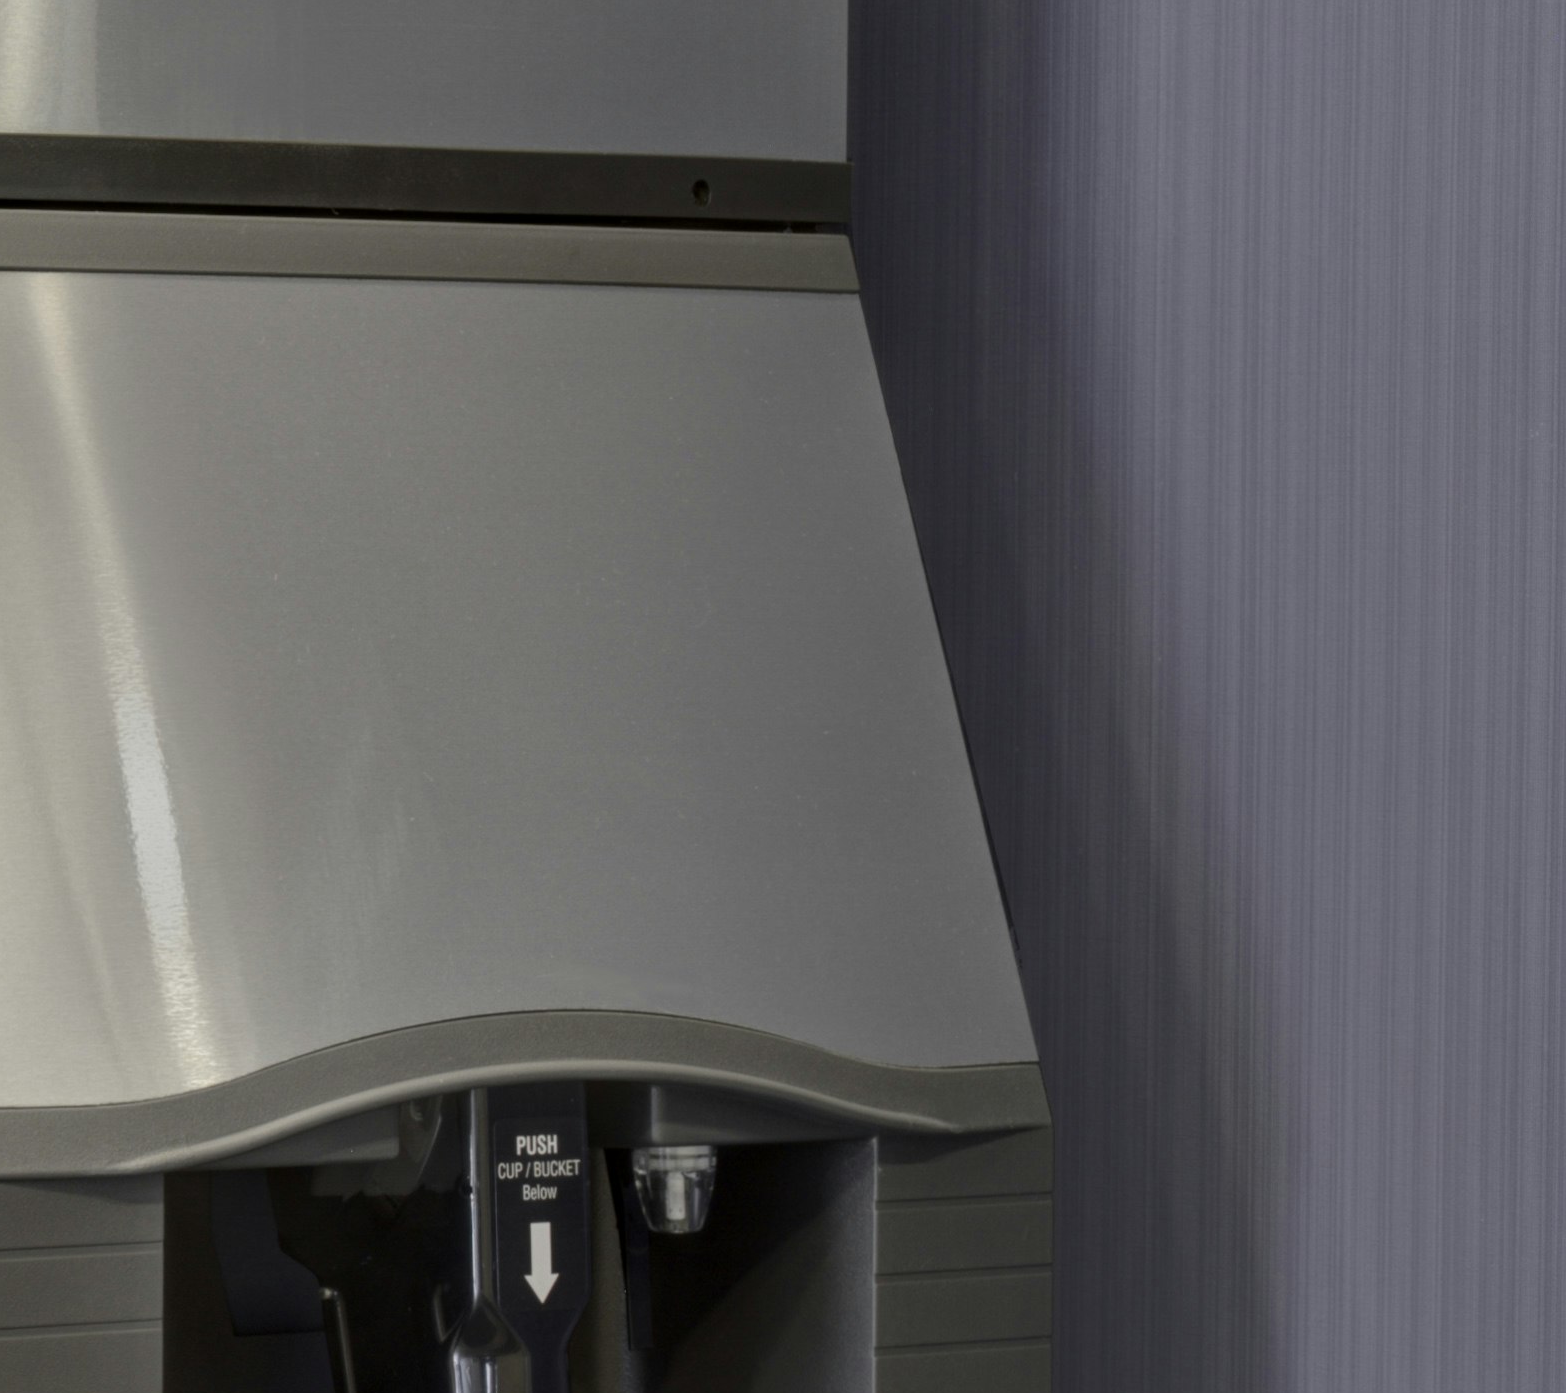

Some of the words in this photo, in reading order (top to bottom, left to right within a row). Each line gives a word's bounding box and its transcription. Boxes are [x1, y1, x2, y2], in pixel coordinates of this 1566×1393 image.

[516, 1134, 558, 1155] PUSH
[497, 1161, 523, 1179] CUP
[533, 1159, 580, 1178] BUCKET
[522, 1184, 557, 1201] Below
